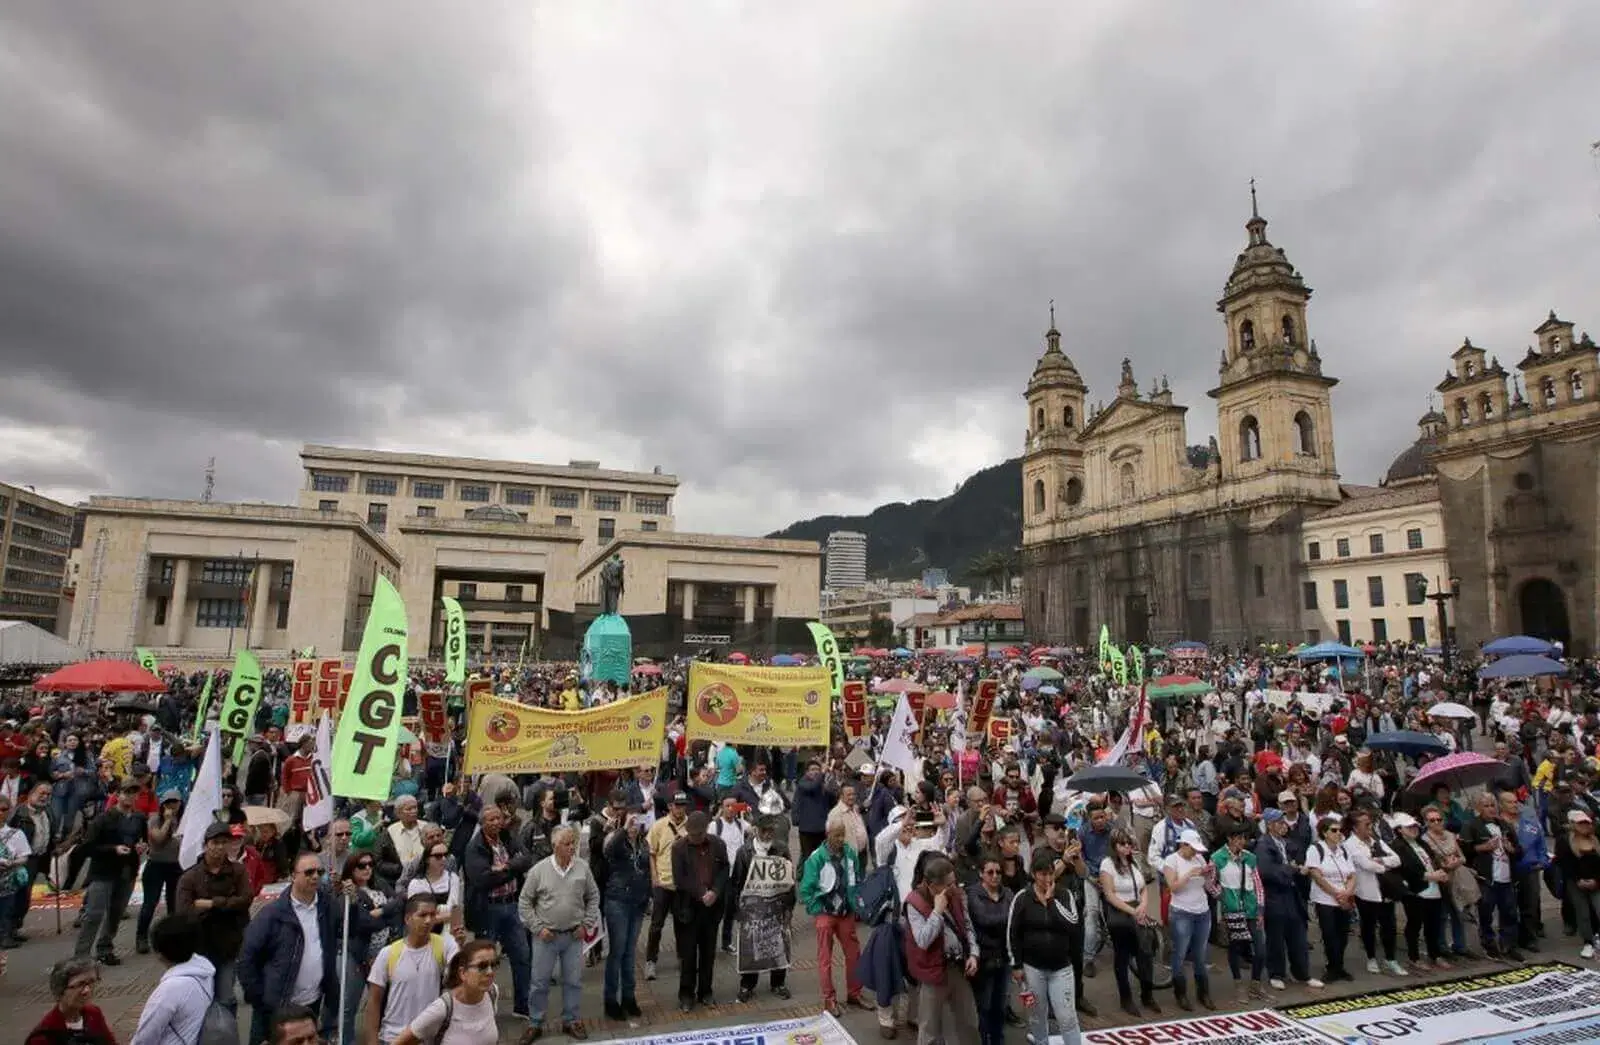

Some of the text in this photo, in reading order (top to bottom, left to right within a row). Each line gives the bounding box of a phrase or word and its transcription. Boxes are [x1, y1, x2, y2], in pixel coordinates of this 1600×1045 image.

[449, 616, 460, 672] CGT
[823, 639, 838, 689] CGT
[293, 662, 313, 723] CUT
[319, 661, 341, 718] CUT
[353, 644, 401, 775] CGT
[844, 685, 866, 736] CUT
[974, 682, 998, 732] CUT
[420, 693, 446, 742] CUT
[750, 861, 786, 881] NO
[1086, 1010, 1286, 1045] SISERVIPUM
[1356, 1017, 1422, 1039] CDP
